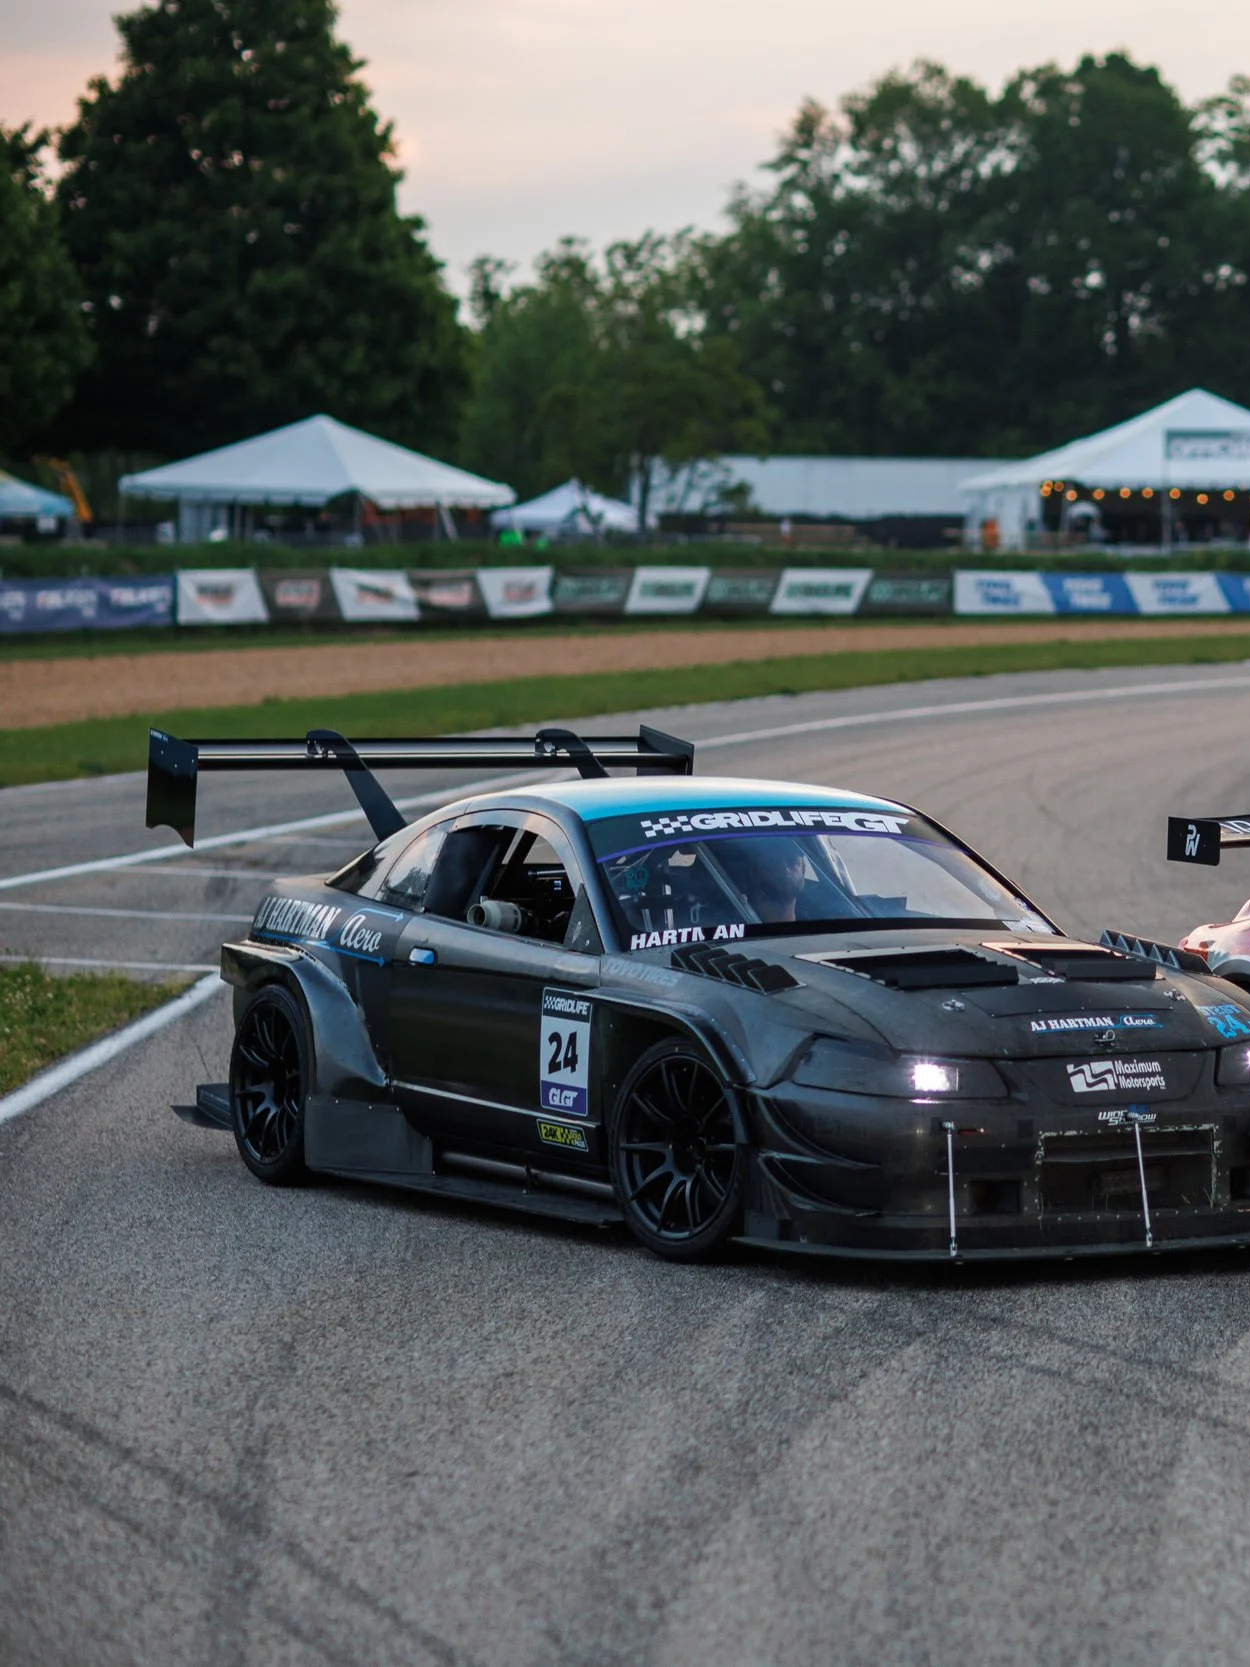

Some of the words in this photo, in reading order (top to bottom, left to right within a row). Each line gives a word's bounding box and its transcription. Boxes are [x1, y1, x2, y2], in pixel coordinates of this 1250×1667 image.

[266, 898, 341, 940] HARTMAN
[340, 914, 382, 952] Aero
[554, 998, 590, 1015] GRIDLIFE
[1030, 1020, 1046, 1031] AJ
[1047, 1016, 1114, 1030] HARTMAN
[1123, 1016, 1155, 1026] Aero
[548, 1031, 578, 1075] 24
[1115, 1059, 1161, 1075] Maximum
[1120, 1075, 1165, 1091] Motorsports
[548, 1087, 578, 1108] GLGT
